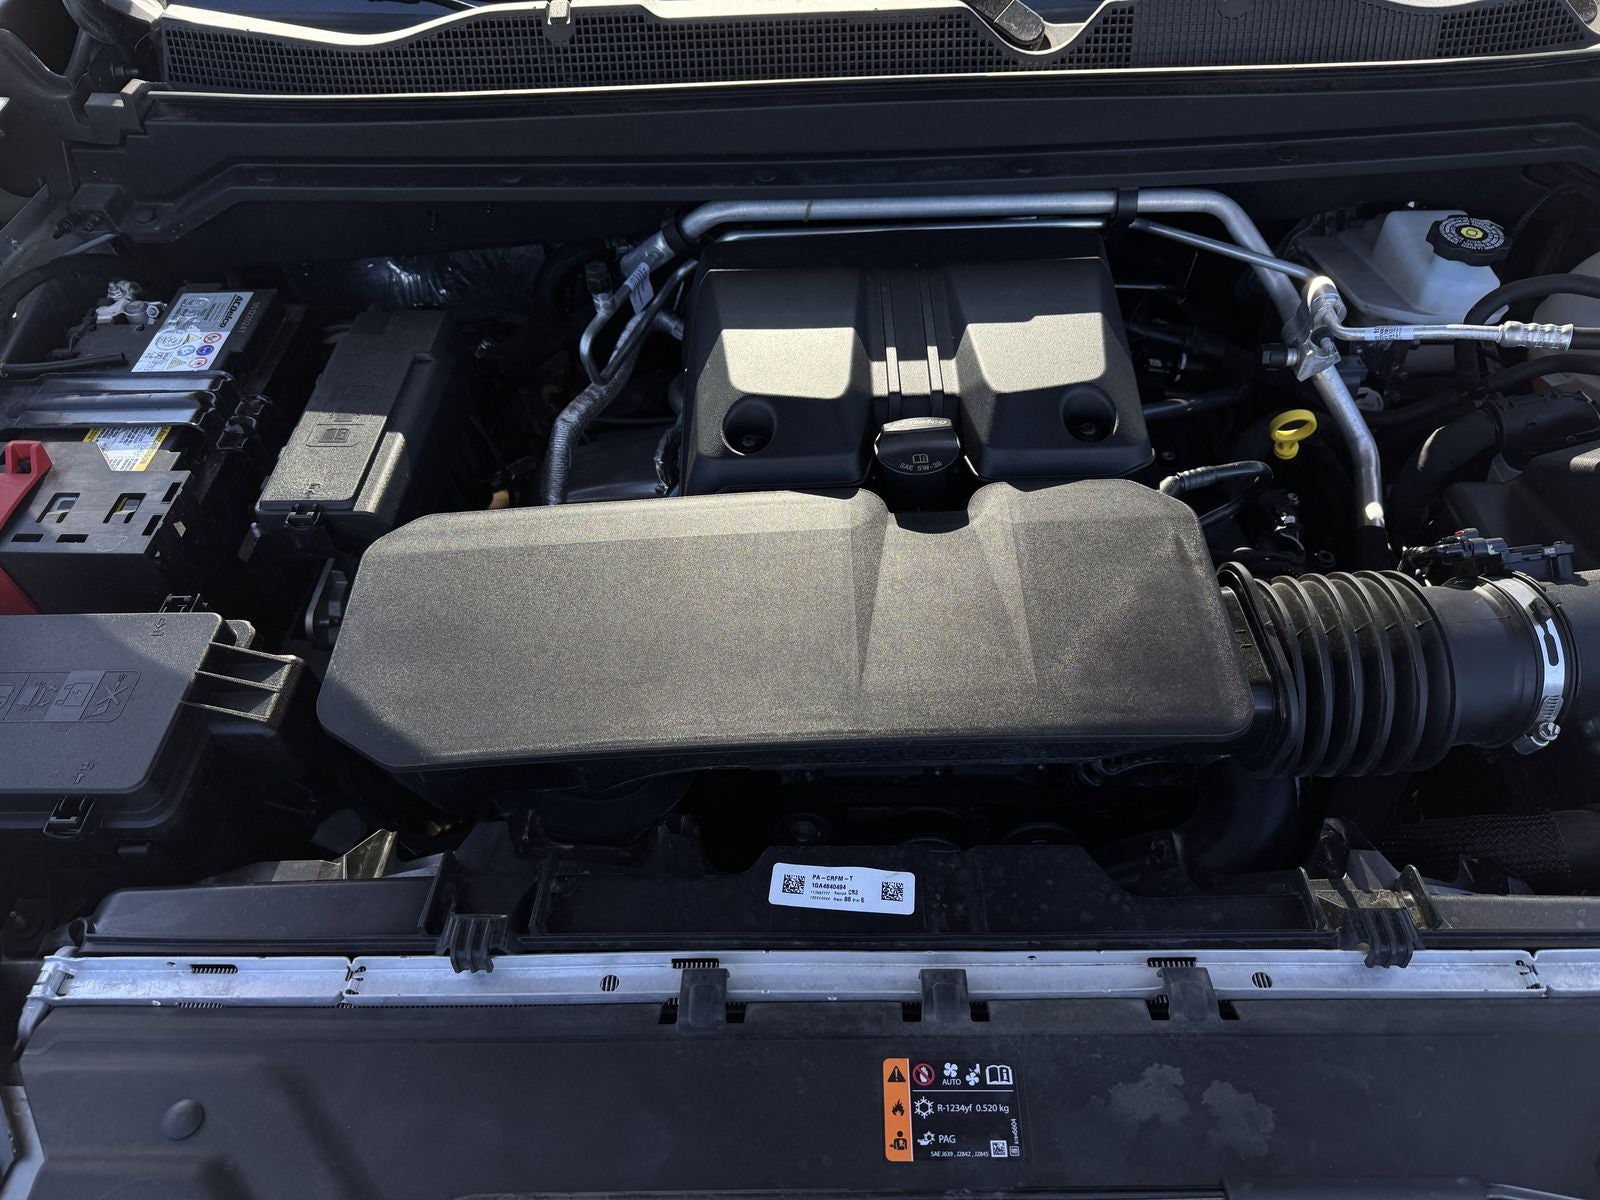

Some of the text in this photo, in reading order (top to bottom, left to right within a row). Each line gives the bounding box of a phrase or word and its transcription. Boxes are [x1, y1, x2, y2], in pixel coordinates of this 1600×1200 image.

[220, 295, 243, 329] ACDelco
[899, 460, 942, 472] SAE 5W-30
[937, 1104, 1010, 1114] R-1234yf 0.520 kg
[938, 1135, 956, 1144] PAG
